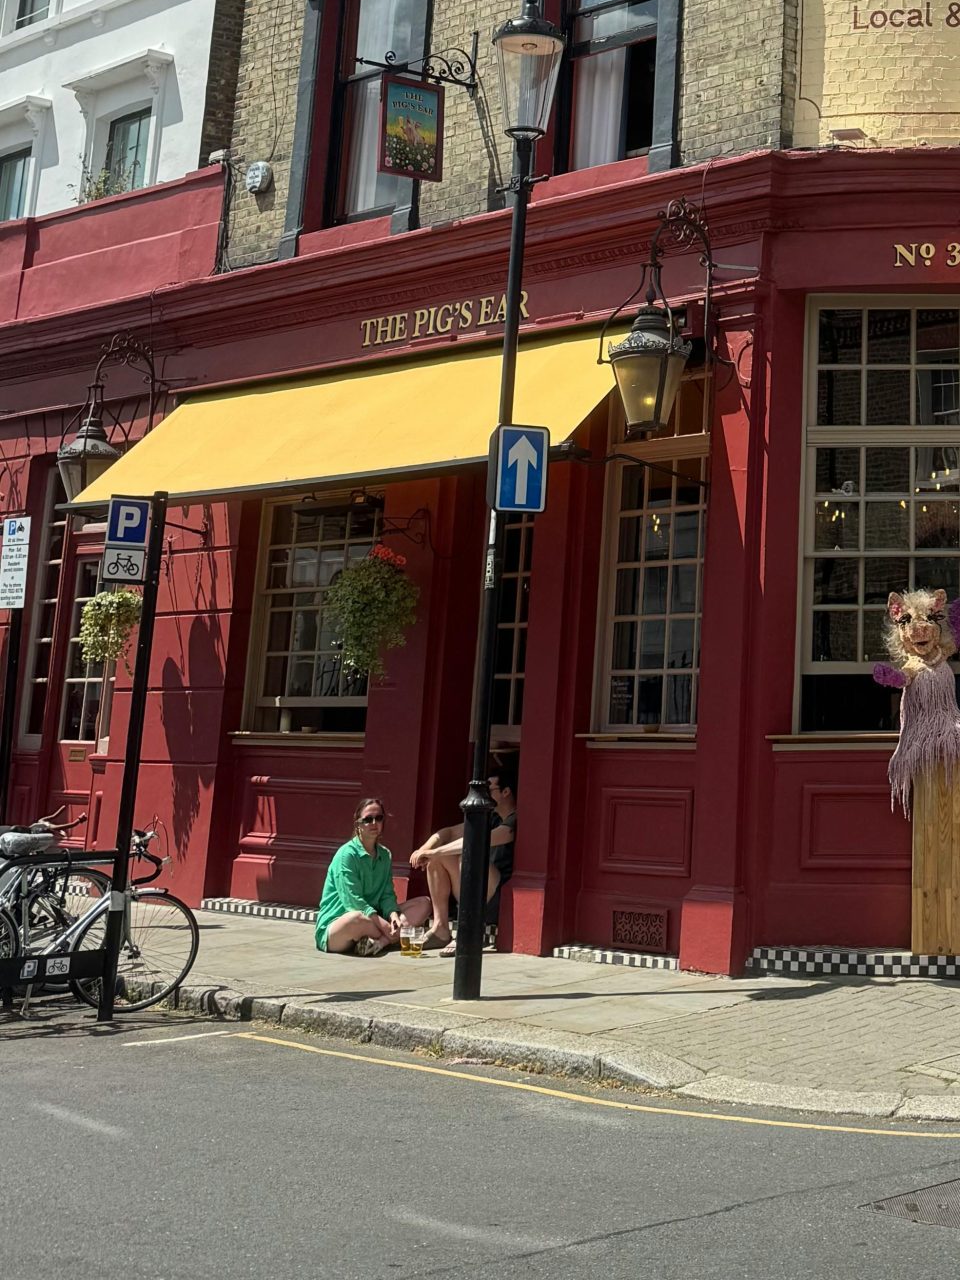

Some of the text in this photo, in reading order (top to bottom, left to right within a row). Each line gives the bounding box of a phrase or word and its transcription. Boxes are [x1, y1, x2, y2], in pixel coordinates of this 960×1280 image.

[853, 2, 932, 31] Local
[404, 91, 424, 102] THE
[417, 104, 434, 116] EAR
[361, 312, 408, 347] THE
[412, 300, 473, 337] PIG'S
[10, 522, 16, 534] P
[116, 505, 141, 538] P
[23, 962, 34, 977] P
